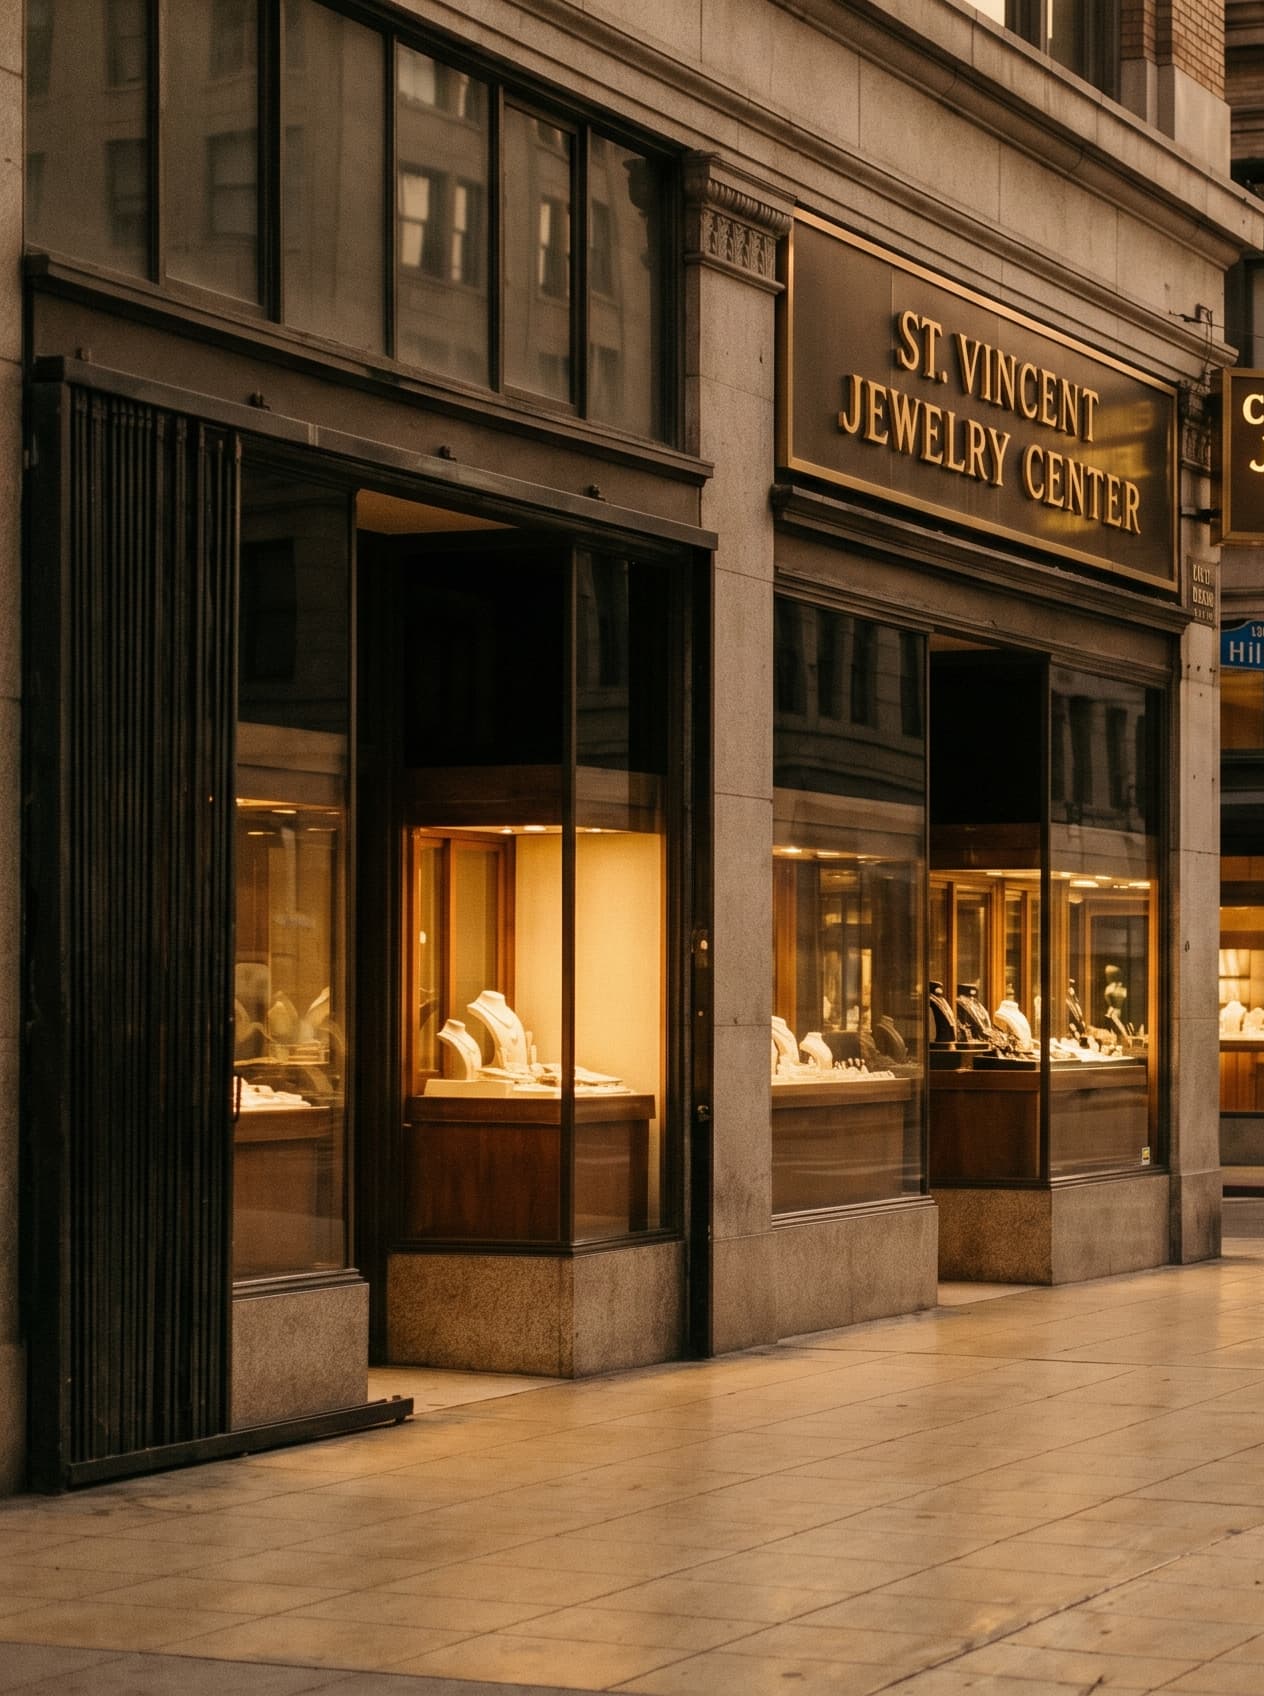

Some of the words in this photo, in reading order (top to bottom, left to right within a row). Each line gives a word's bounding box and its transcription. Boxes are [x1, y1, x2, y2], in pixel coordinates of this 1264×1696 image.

[896, 310, 948, 384] ST.
[955, 332, 1100, 442] VINCENT
[838, 374, 1011, 487] JEWELRY
[1022, 444, 1142, 534] CENTER
